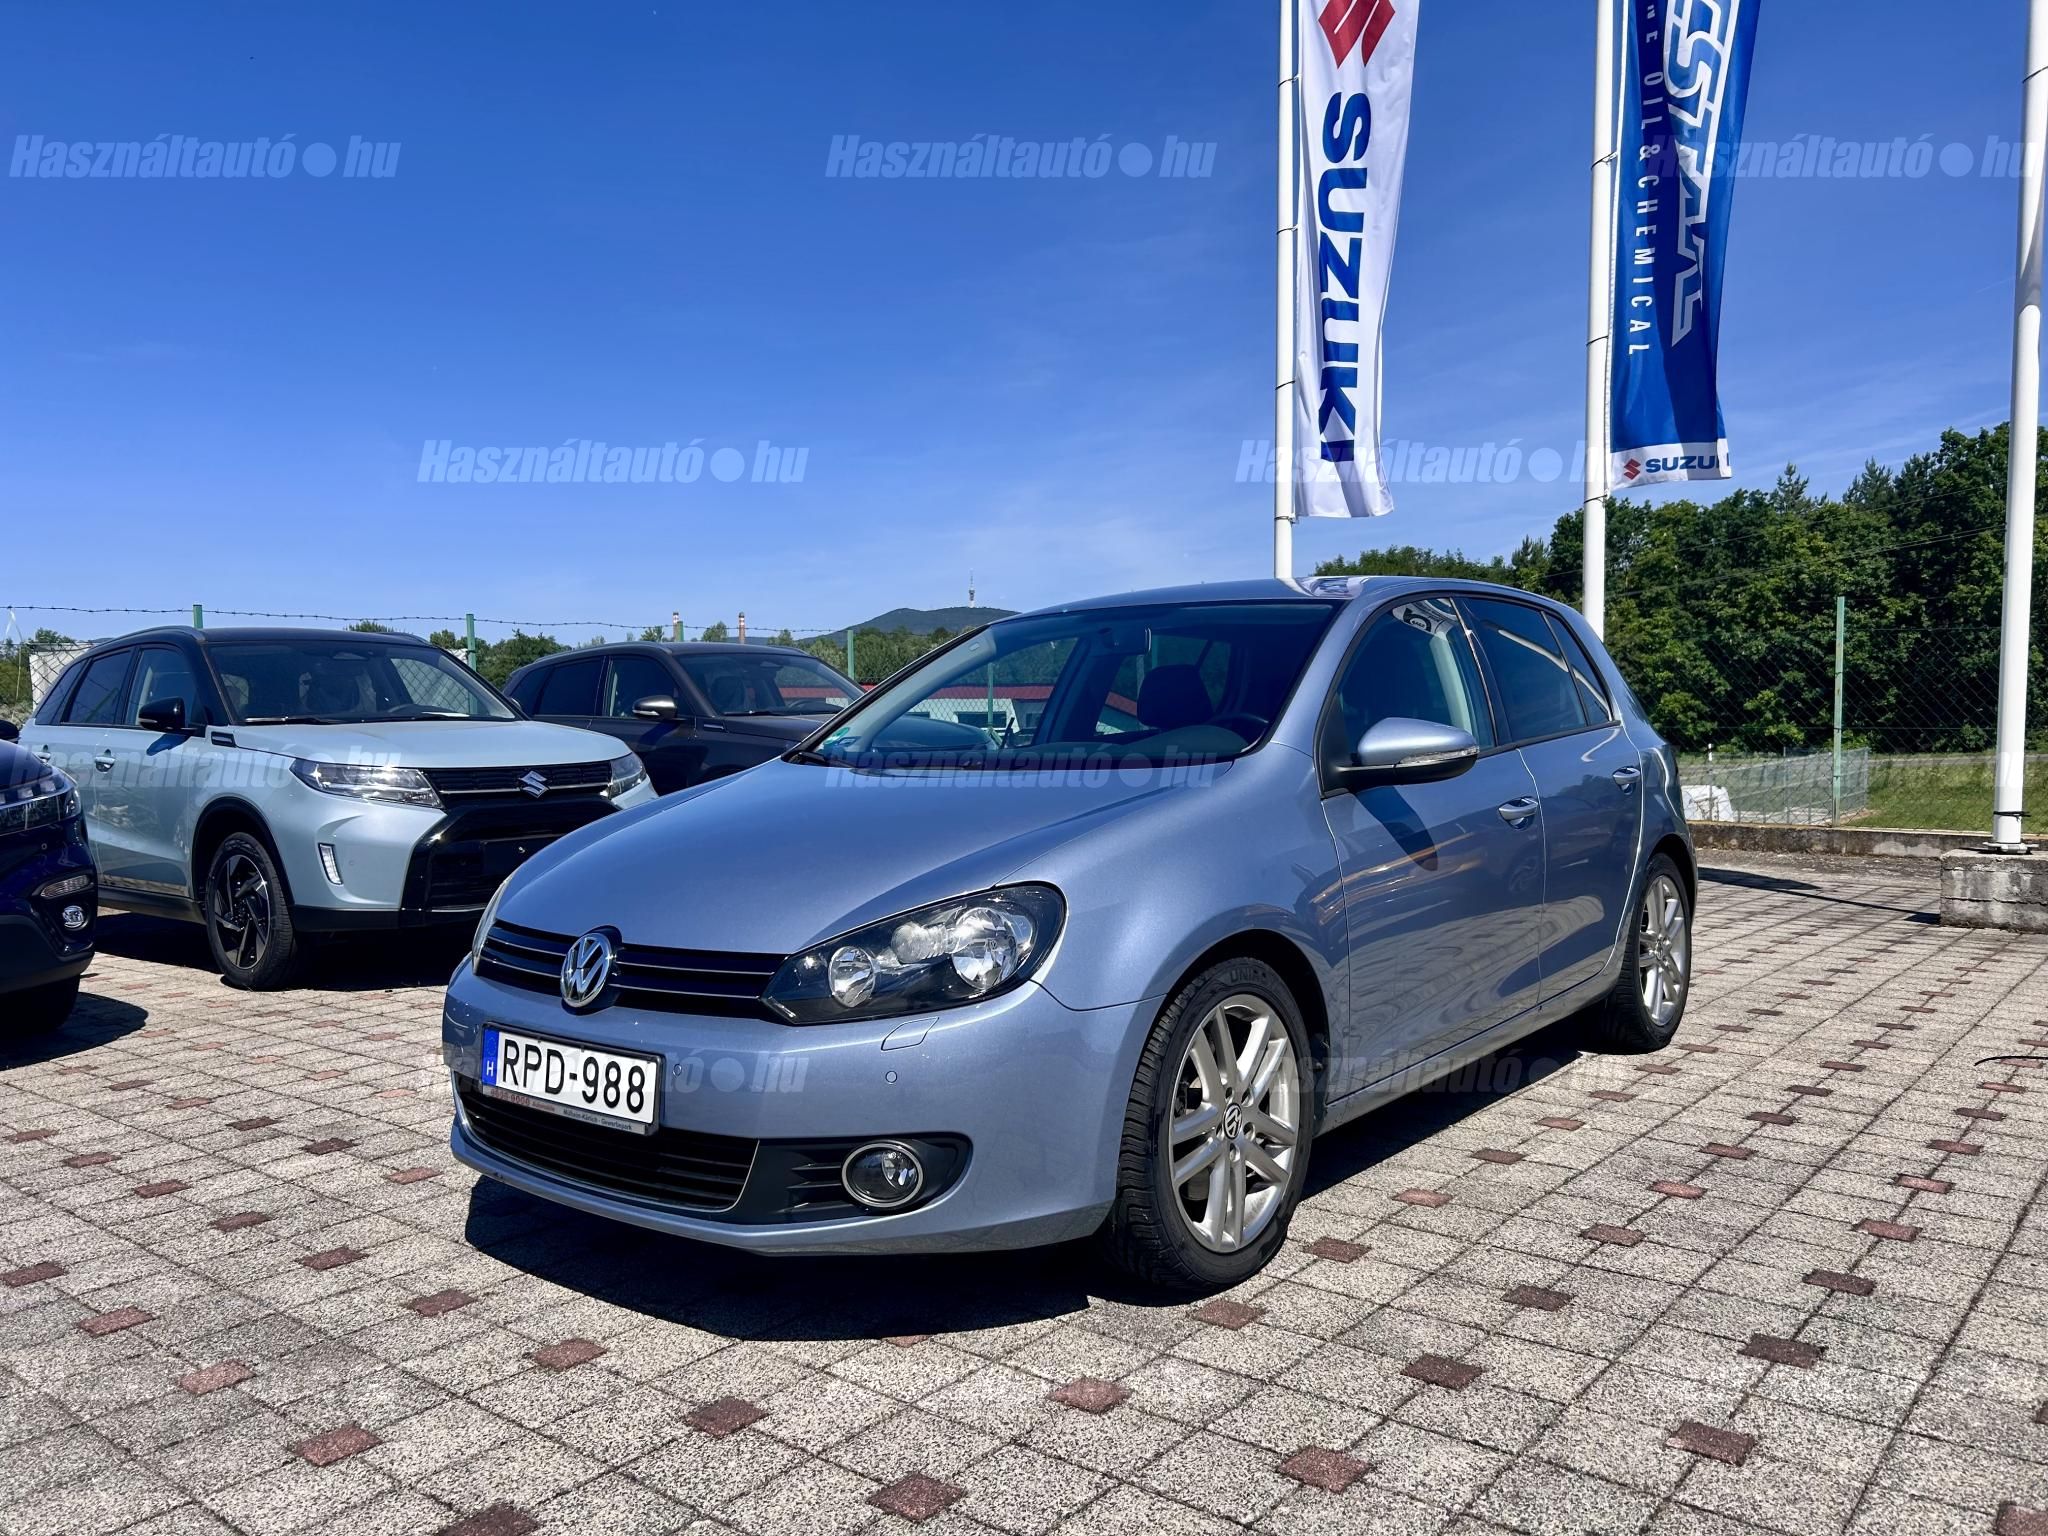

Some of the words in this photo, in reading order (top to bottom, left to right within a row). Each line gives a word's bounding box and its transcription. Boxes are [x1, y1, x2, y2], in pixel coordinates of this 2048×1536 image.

[1318, 91, 1372, 462] SUZUKI
[486, 1060, 494, 1077] H
[502, 1038, 646, 1114] RPD-988
